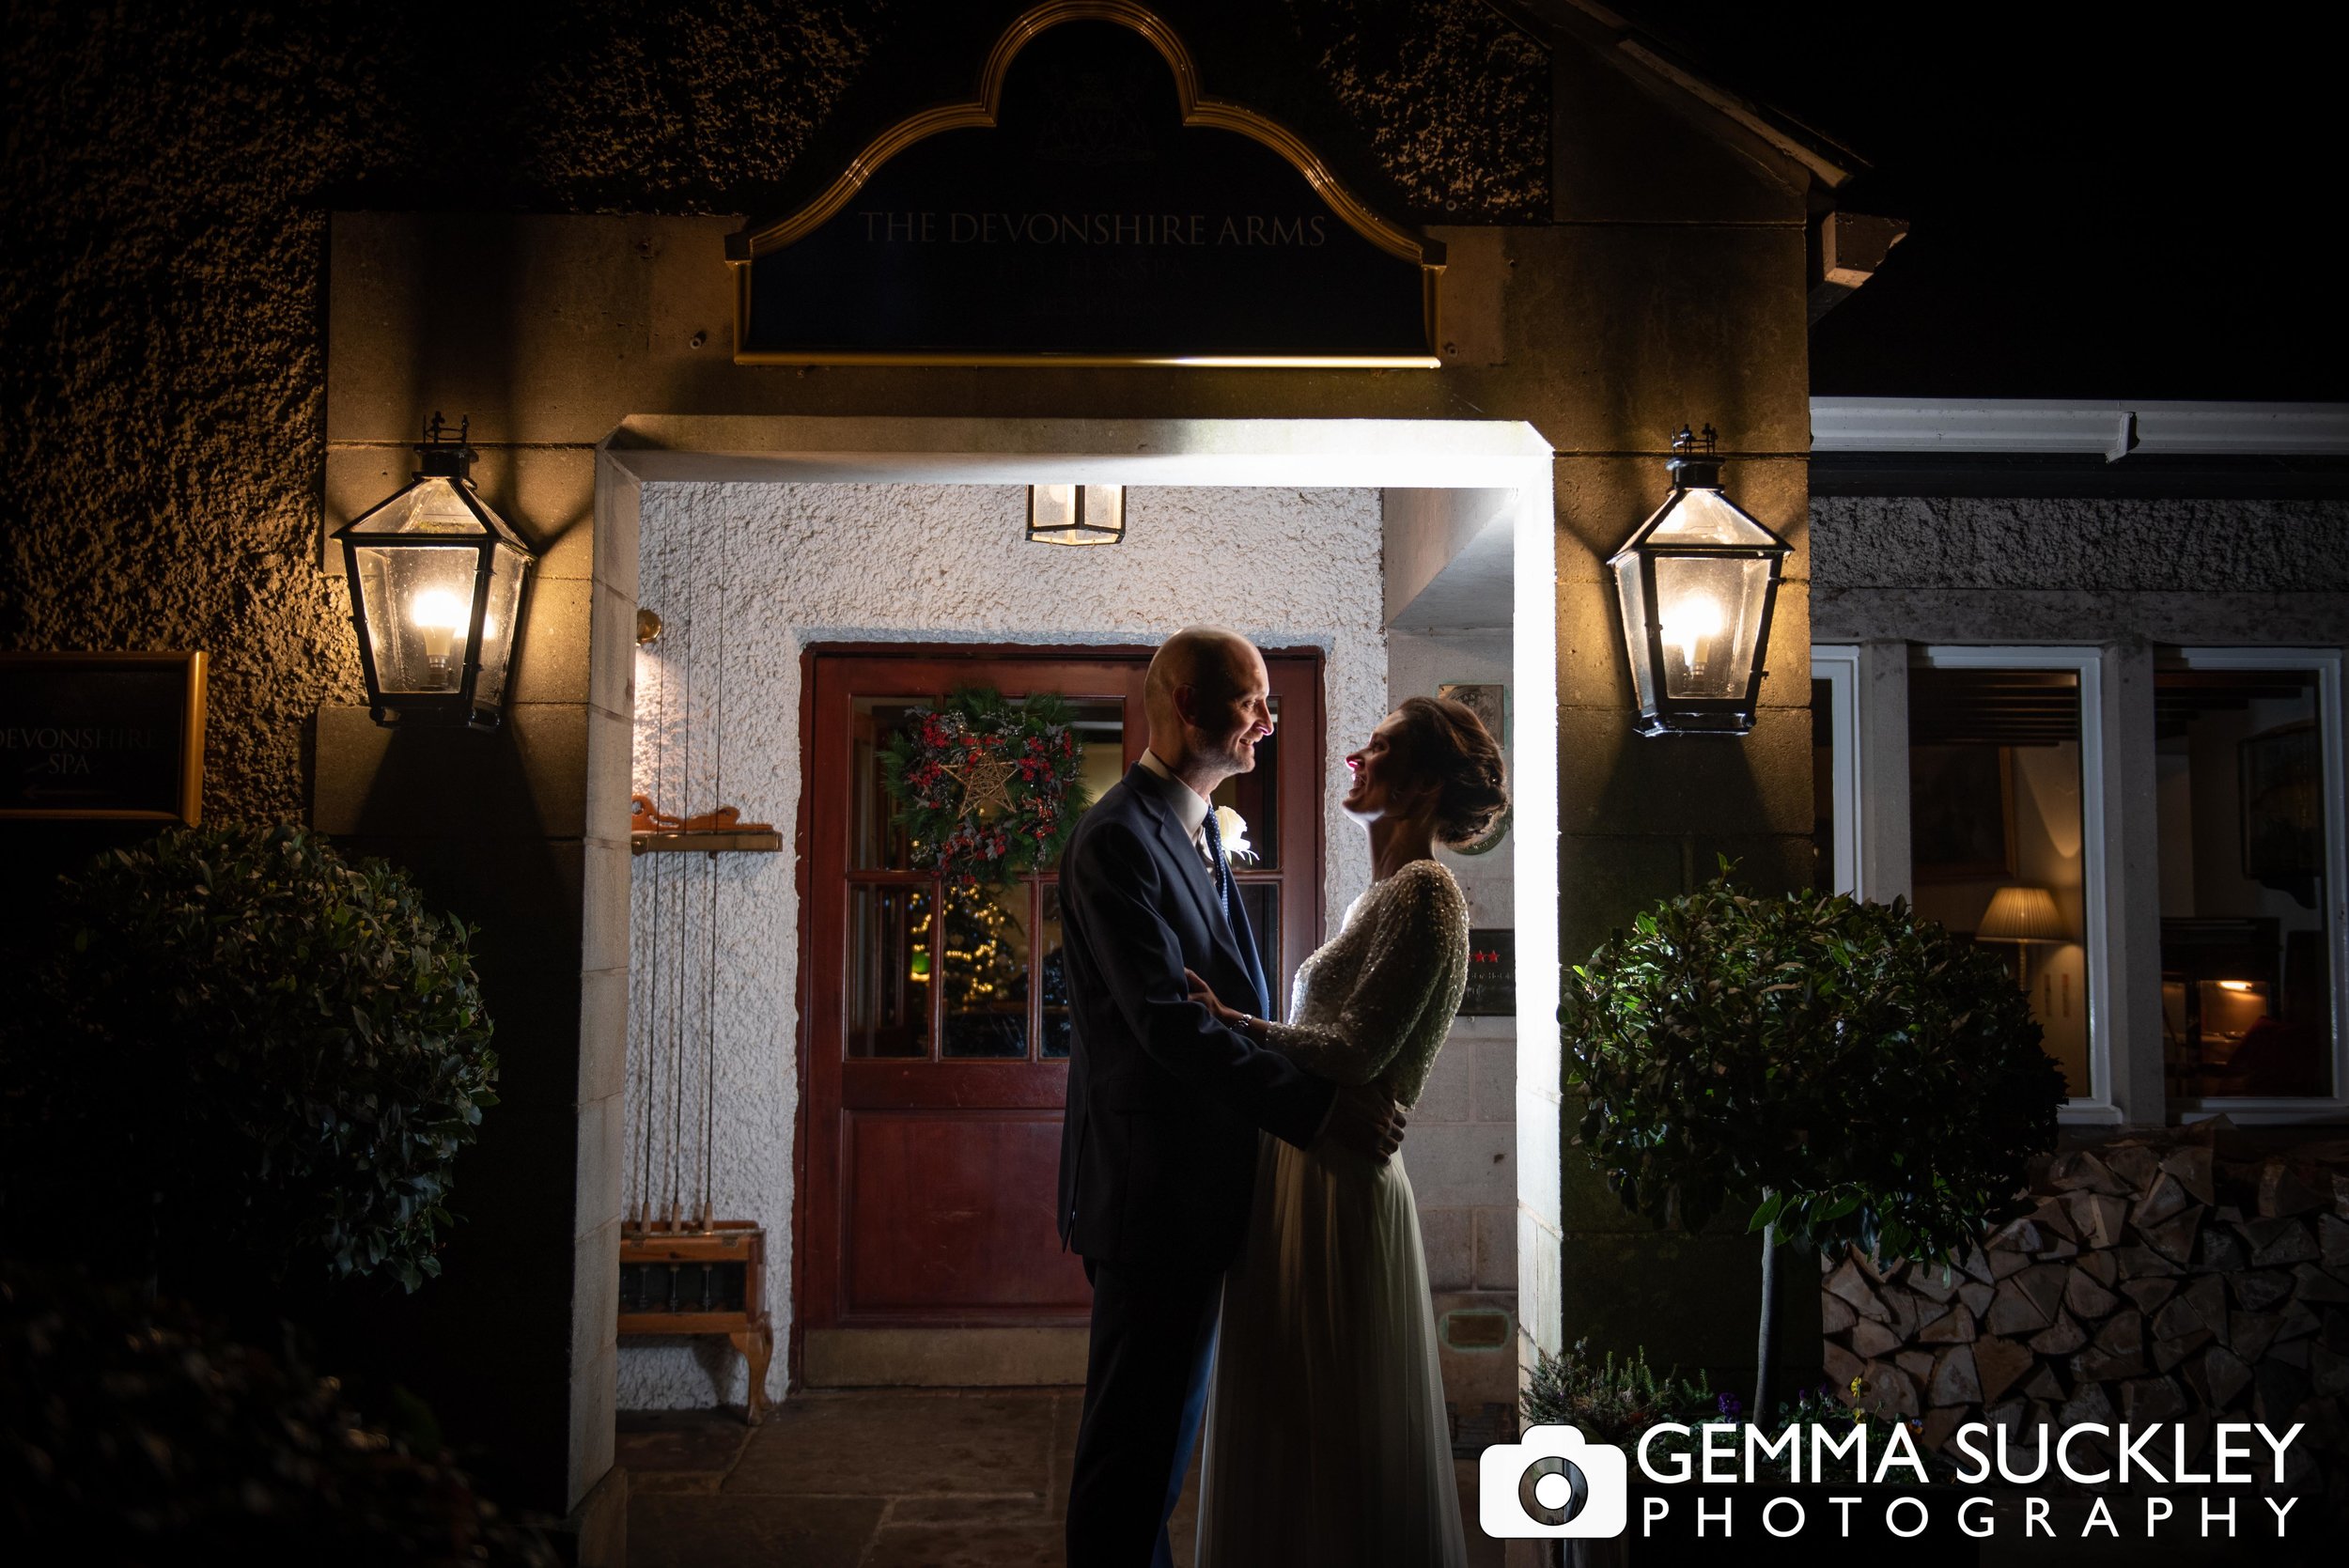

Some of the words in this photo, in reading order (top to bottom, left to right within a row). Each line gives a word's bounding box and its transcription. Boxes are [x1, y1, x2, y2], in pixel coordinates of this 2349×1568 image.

[859, 211, 936, 242] THE
[950, 212, 1206, 245] DEVONSHIRE
[1217, 215, 1327, 246] ARMS
[48, 753, 91, 775] SPA
